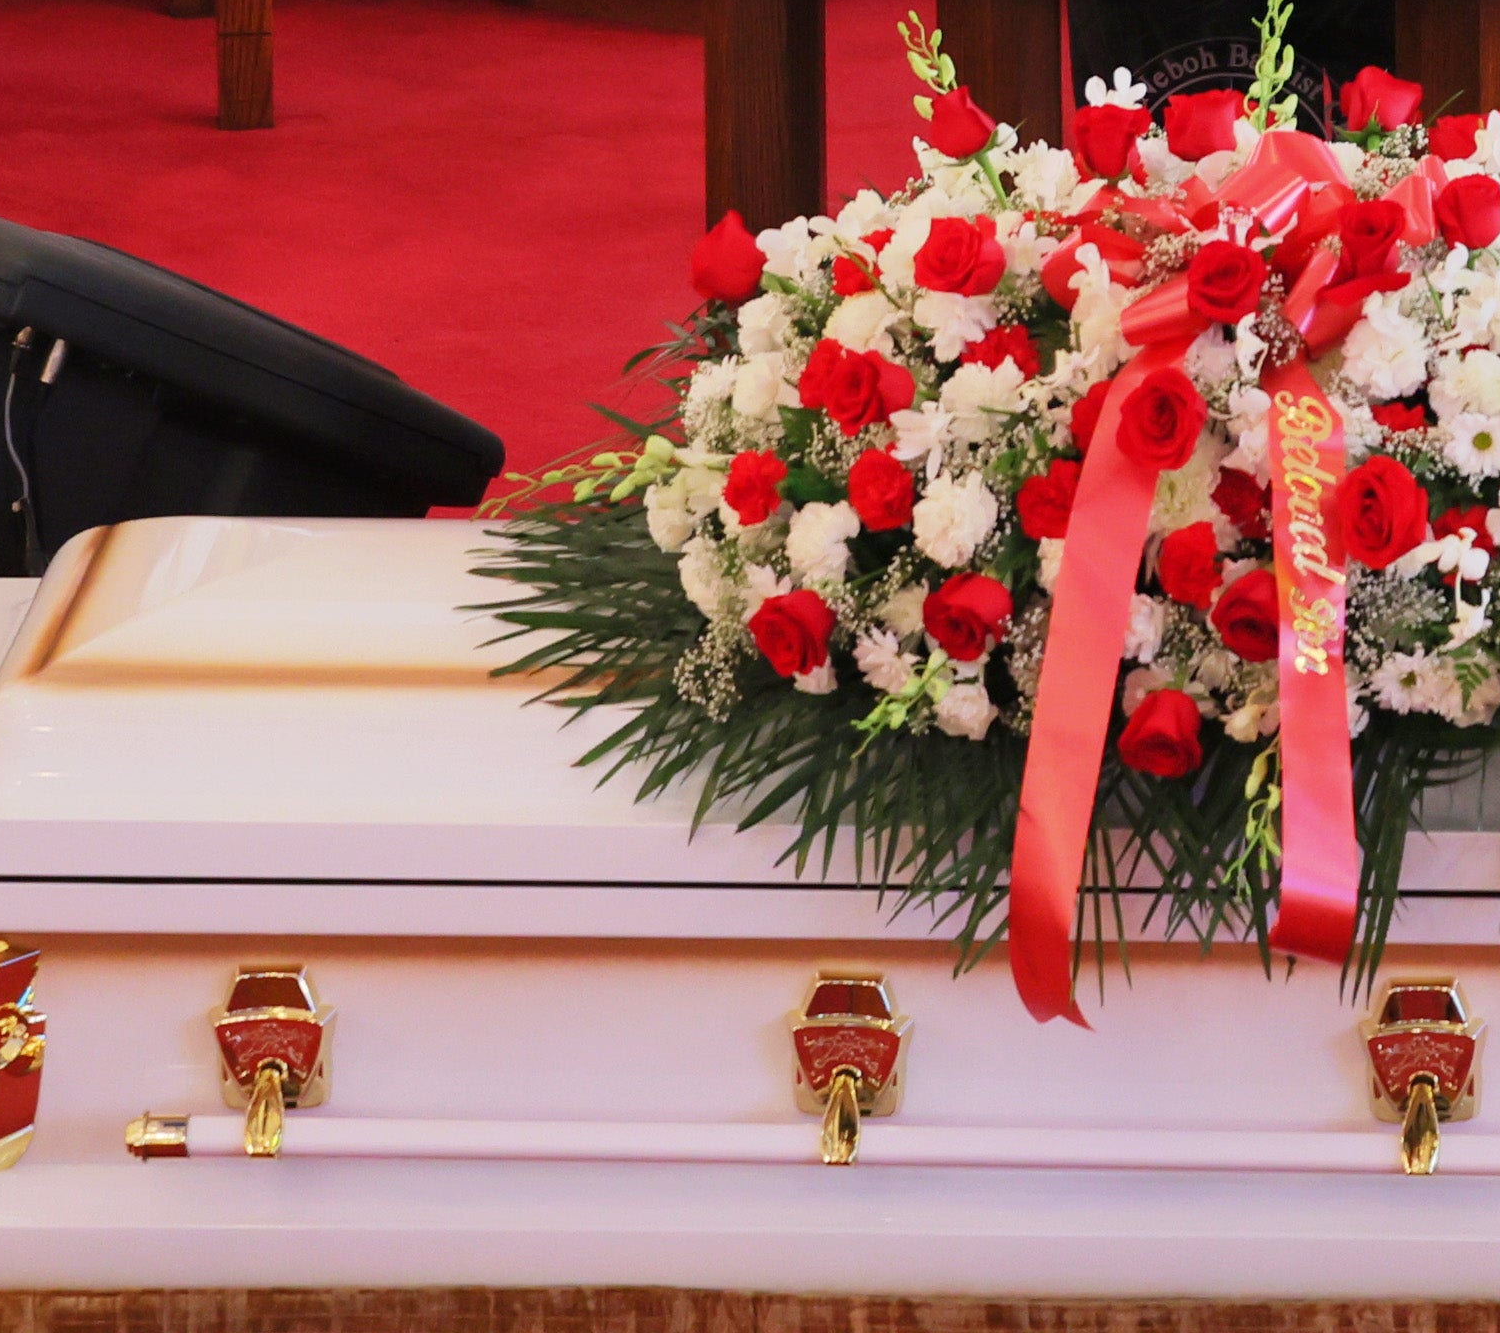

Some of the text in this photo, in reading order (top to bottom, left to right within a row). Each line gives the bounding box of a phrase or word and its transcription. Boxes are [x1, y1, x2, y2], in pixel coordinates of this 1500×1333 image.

[1228, 43, 1323, 101] Baist
[1274, 390, 1347, 676] Beloved Son
